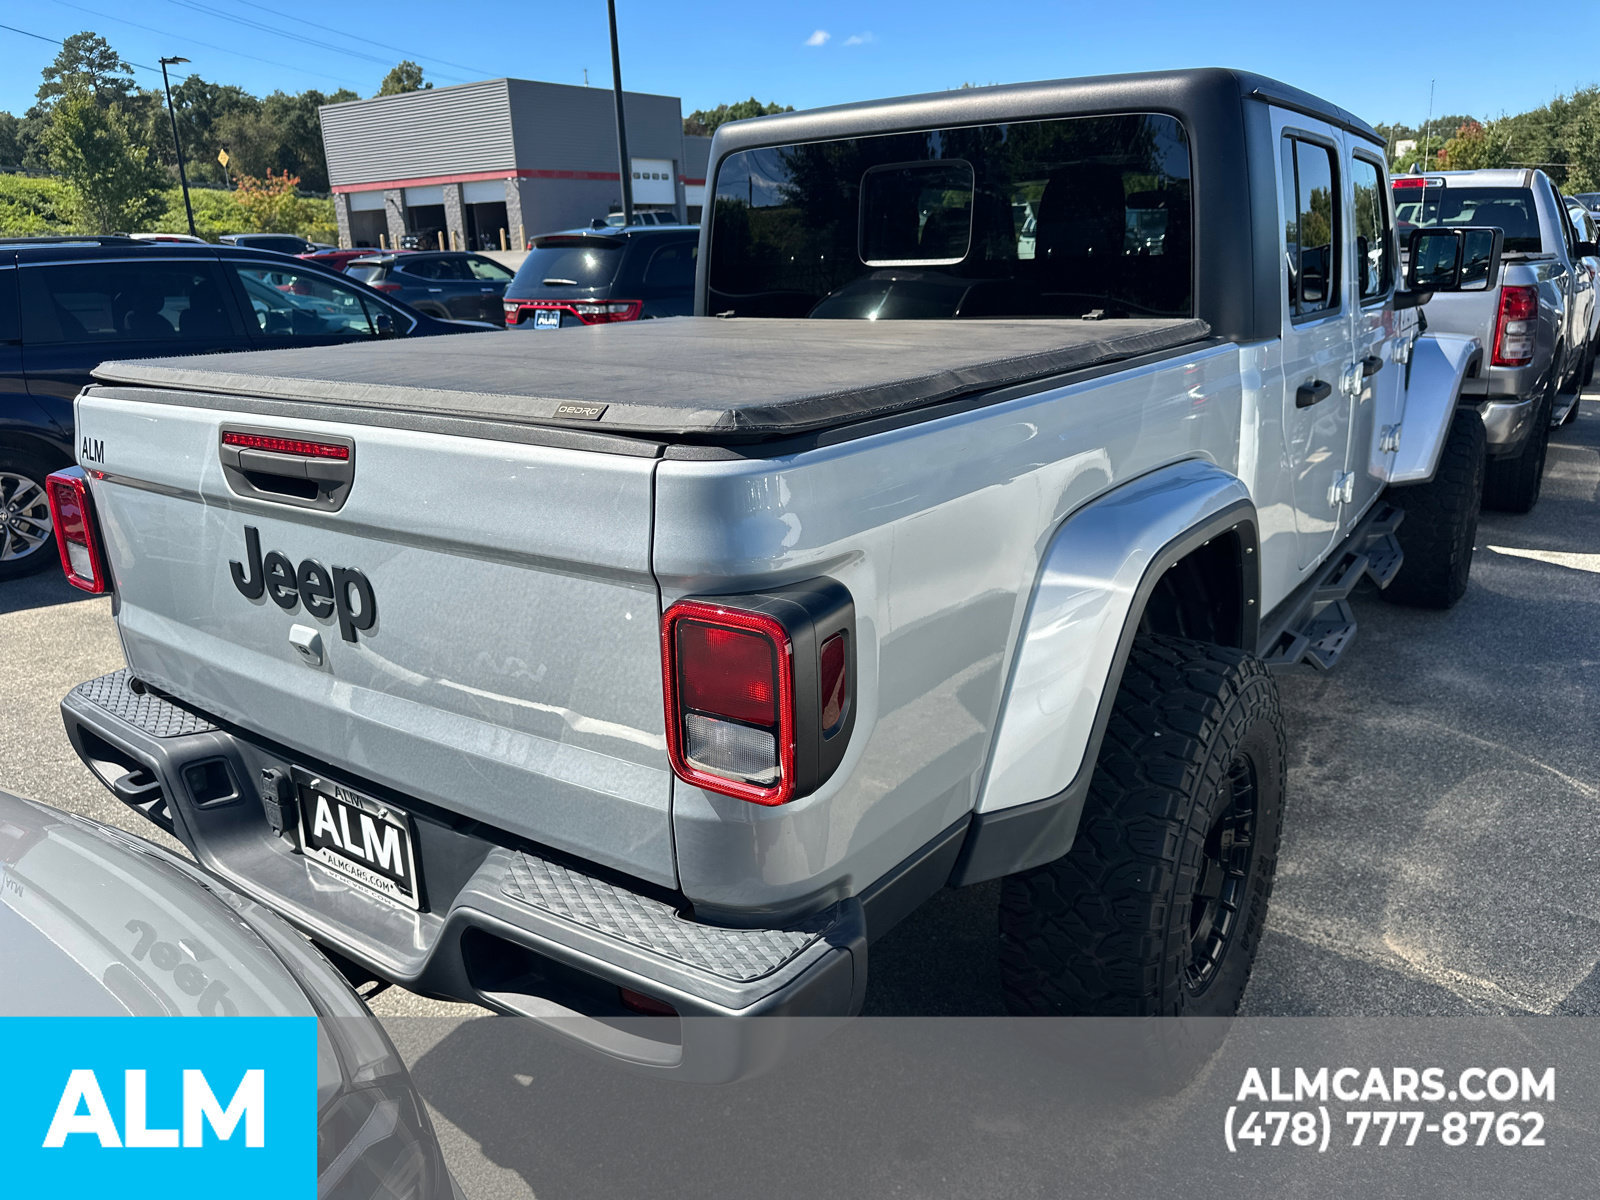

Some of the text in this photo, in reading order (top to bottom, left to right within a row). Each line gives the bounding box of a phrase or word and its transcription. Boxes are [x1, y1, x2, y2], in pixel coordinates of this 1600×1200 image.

[81, 436, 105, 465] ALM
[229, 524, 377, 643] Jeep
[335, 785, 364, 809] ALM
[313, 795, 405, 877] ALM
[327, 854, 391, 892] ALMCARS.COM
